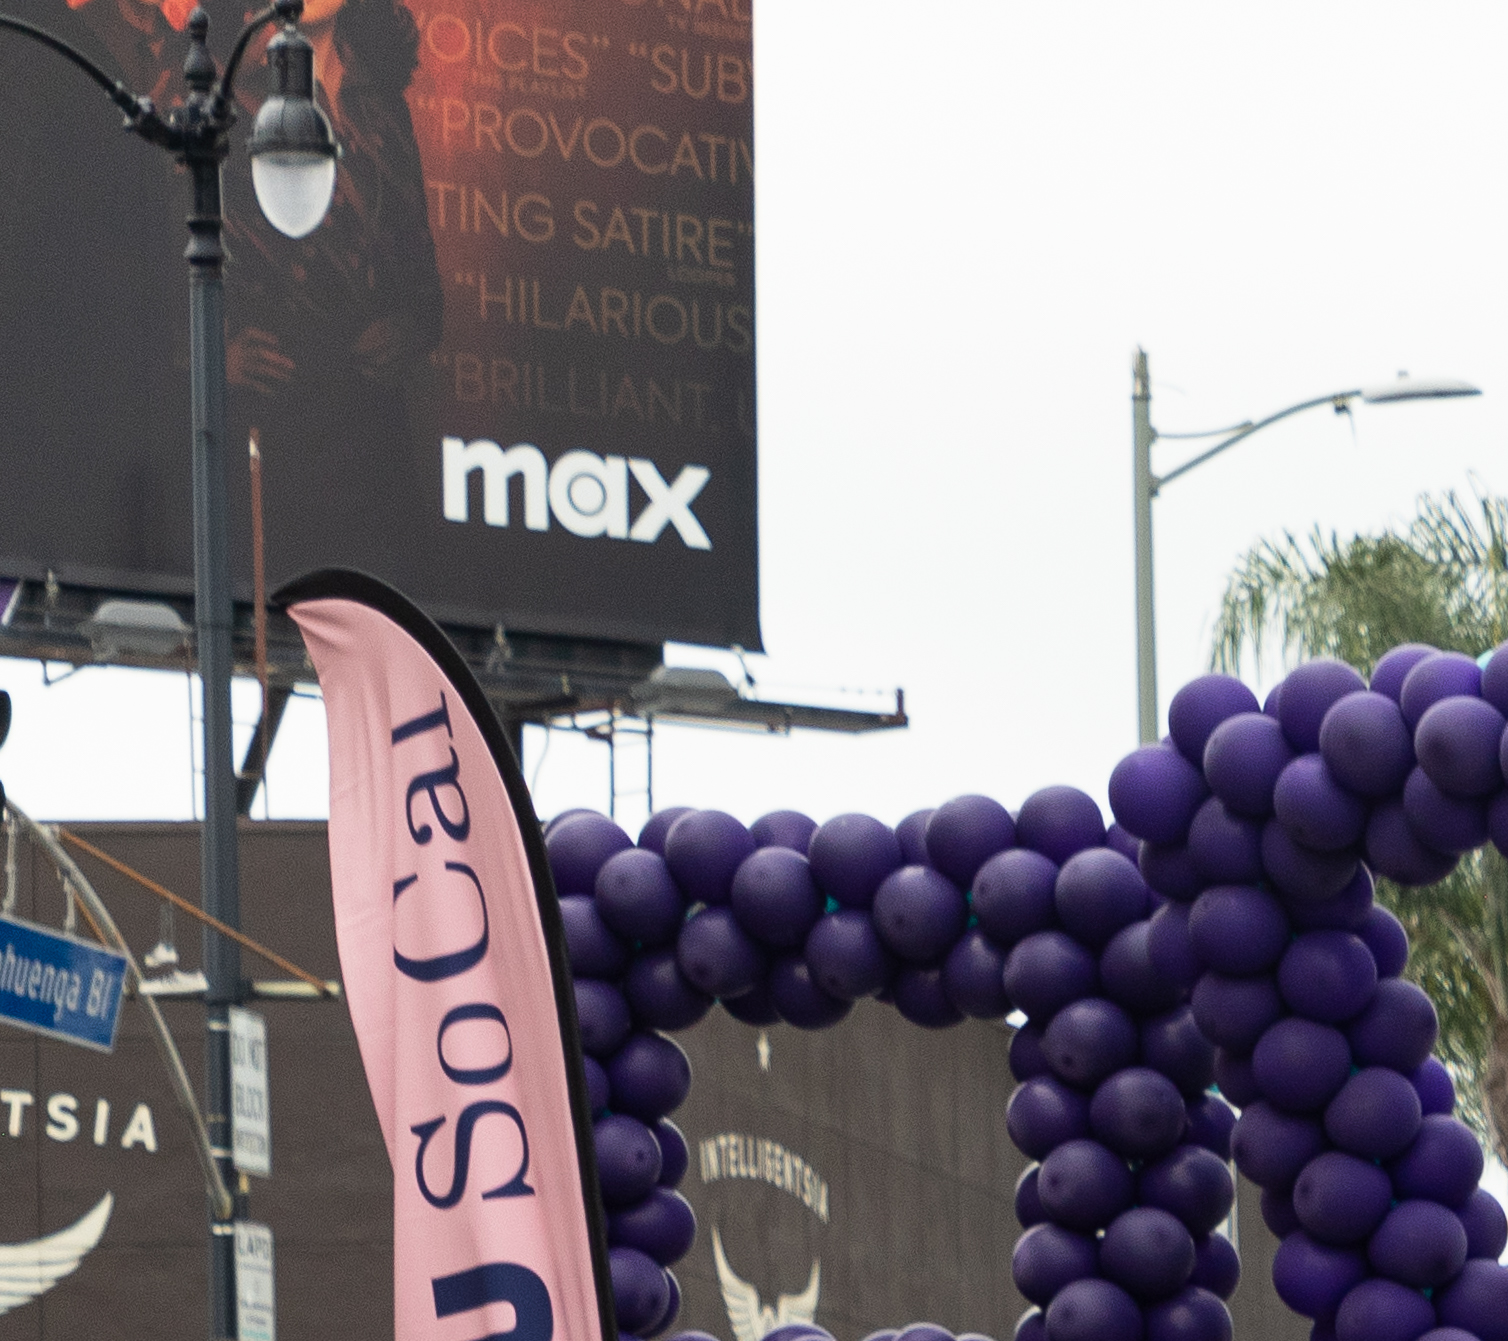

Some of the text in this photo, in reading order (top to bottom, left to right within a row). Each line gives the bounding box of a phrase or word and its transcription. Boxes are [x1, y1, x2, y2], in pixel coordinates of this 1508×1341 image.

[416, 11, 752, 104] OICES" "SUB
[442, 436, 712, 550] max
[0, 944, 114, 1021] huenga Bl
[391, 690, 536, 1210] SoCal
